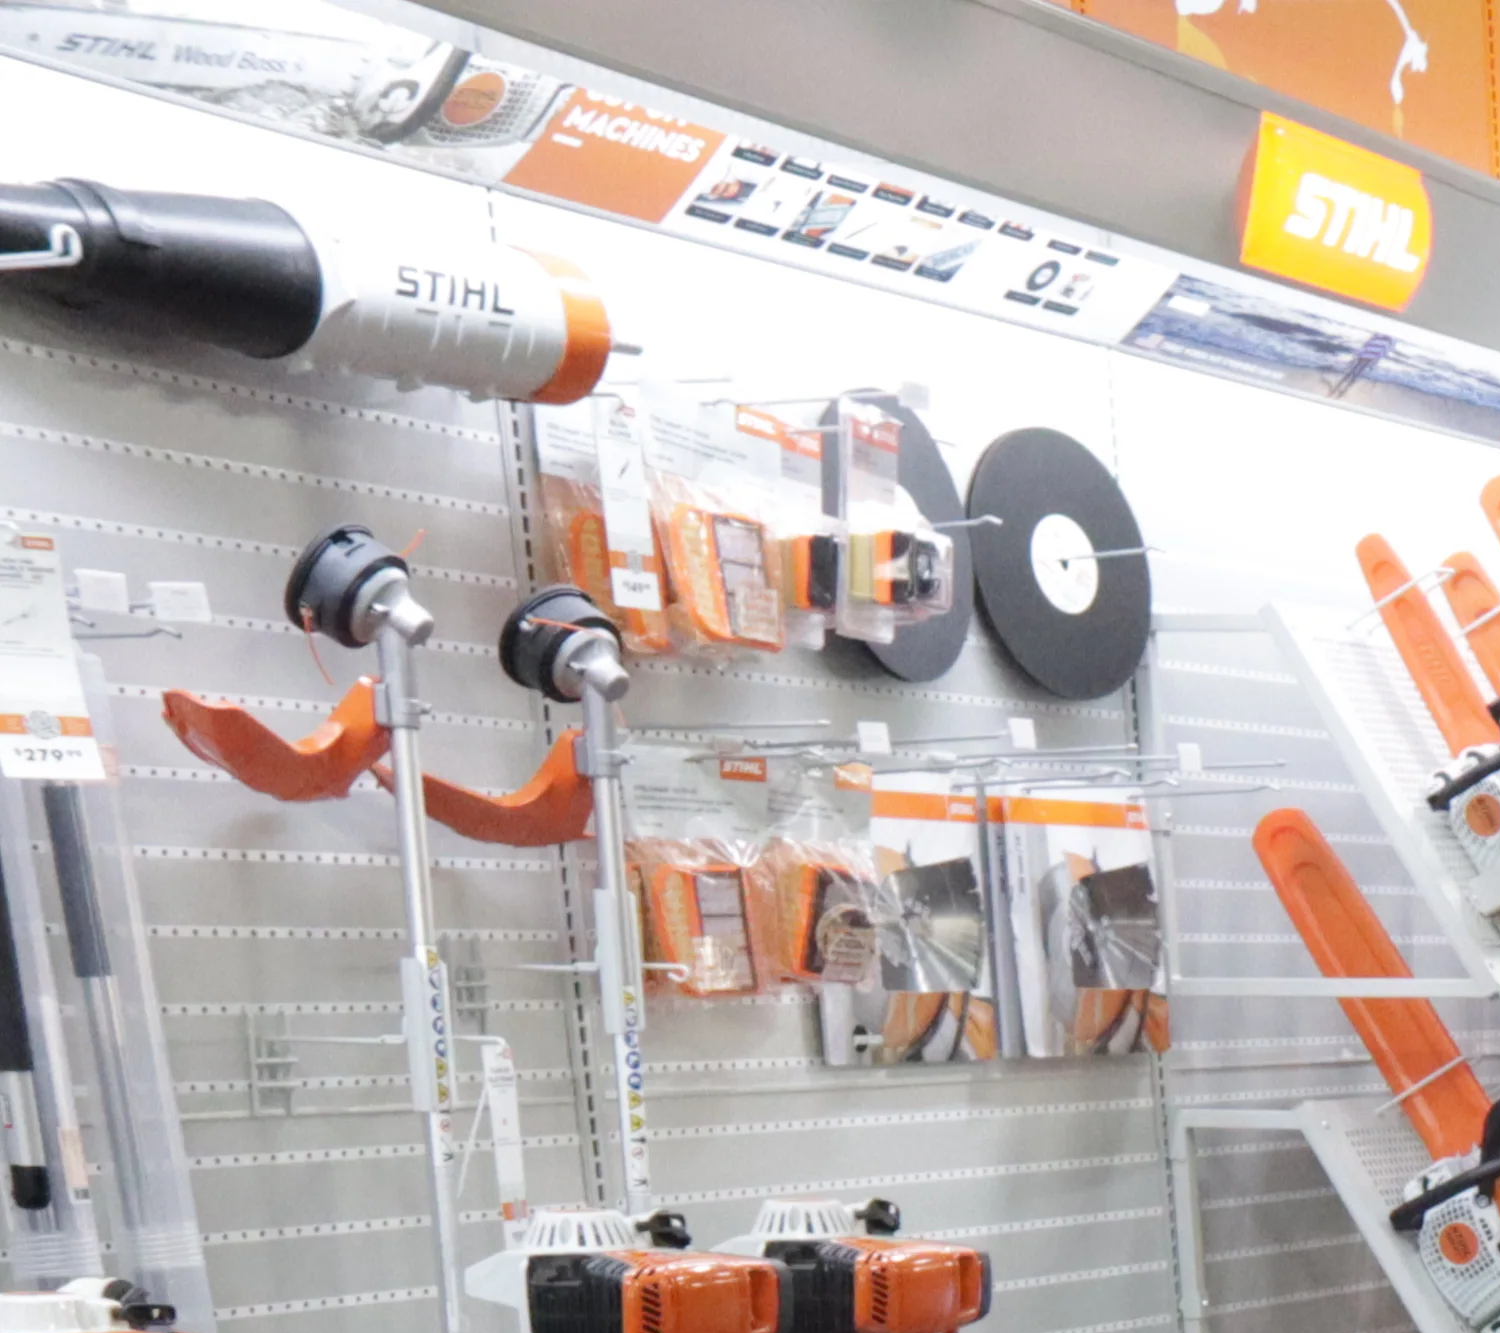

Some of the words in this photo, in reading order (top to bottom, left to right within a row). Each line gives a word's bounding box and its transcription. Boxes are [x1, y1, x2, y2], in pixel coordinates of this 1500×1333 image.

[56, 32, 157, 61] STIHL
[562, 105, 707, 162] MACHINES
[1283, 171, 1421, 263] STIHL
[395, 264, 514, 316] STIHL
[723, 760, 763, 775] STIHL
